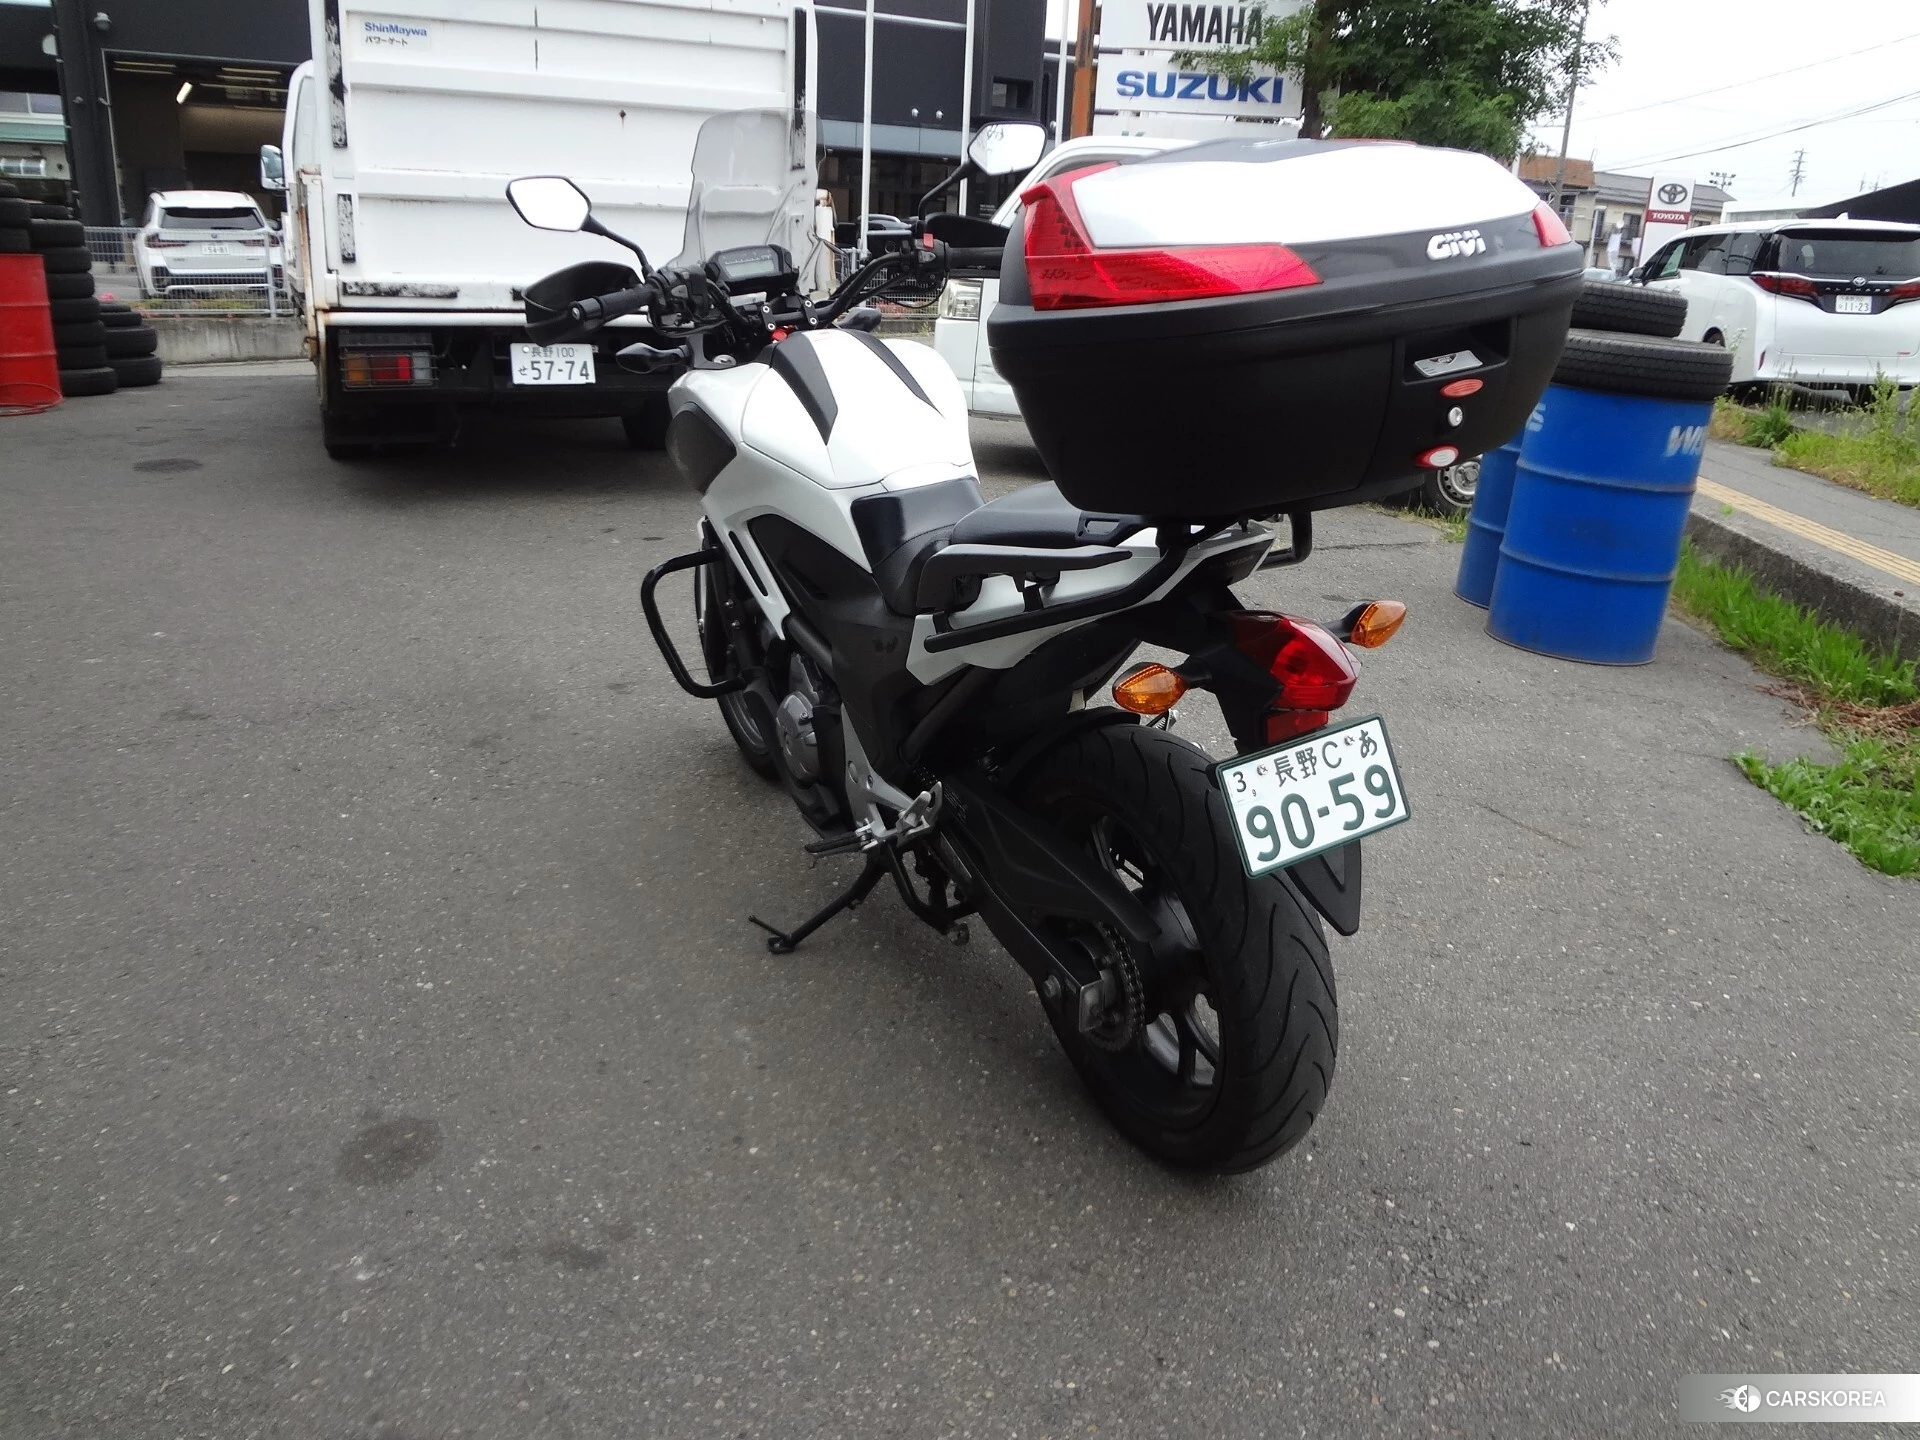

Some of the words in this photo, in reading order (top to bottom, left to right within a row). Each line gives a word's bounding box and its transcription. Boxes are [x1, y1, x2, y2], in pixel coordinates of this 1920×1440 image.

[364, 22, 427, 36] ShinMaywa
[1147, 3, 1262, 45] YAMAHA
[1116, 70, 1284, 104] SUZUKI
[1652, 212, 1685, 220] TOYOTA
[1844, 302, 1869, 312] 11-23
[531, 361, 590, 380] 57-74
[1233, 771, 1246, 792] 3
[1245, 764, 1397, 862] 90-59
